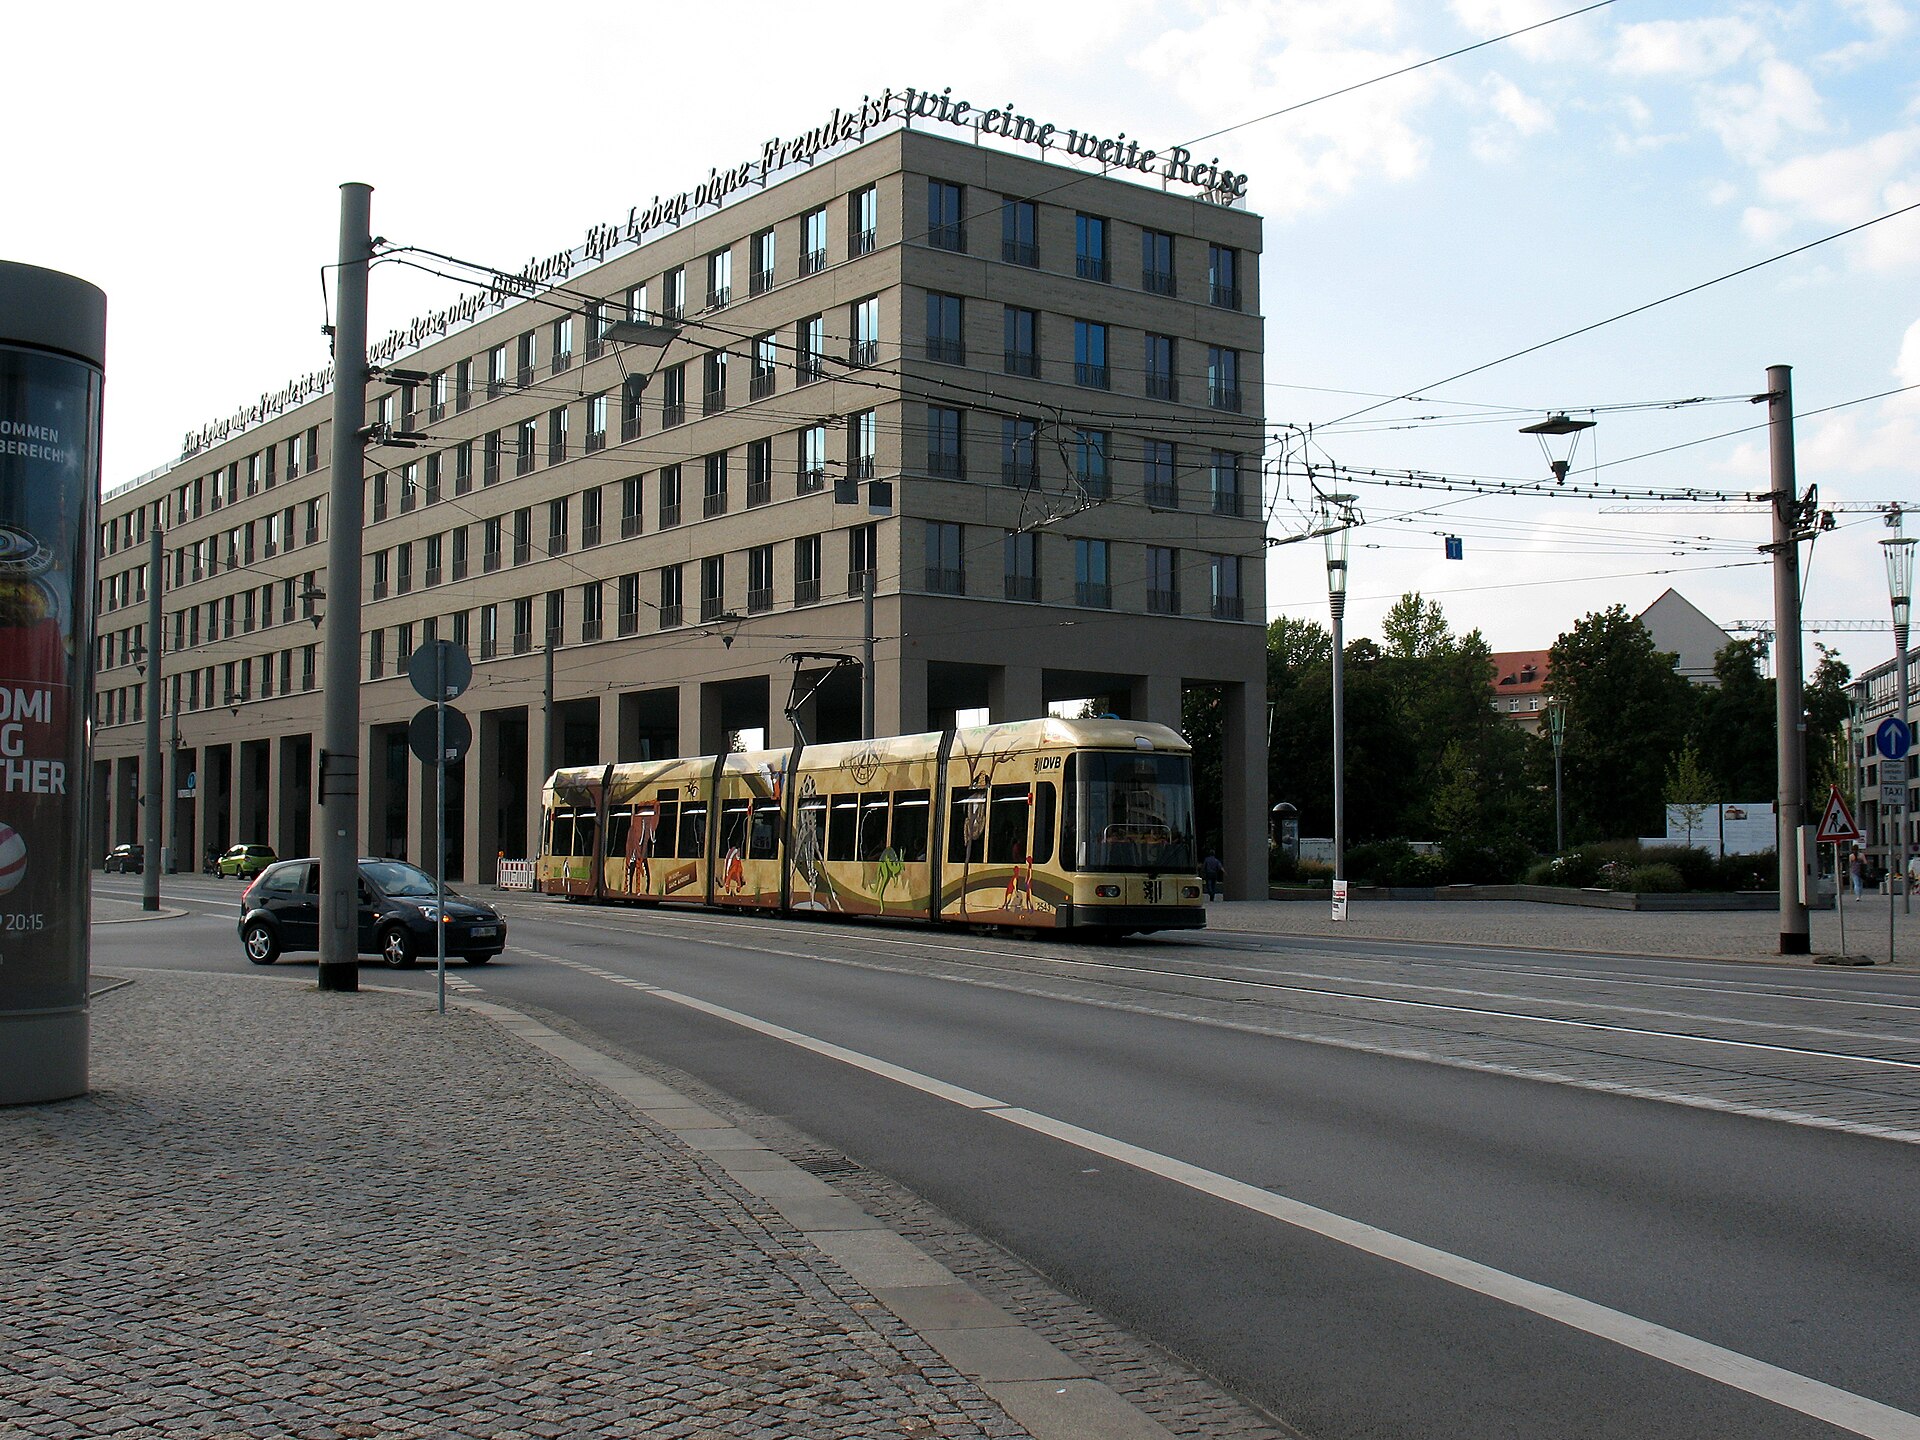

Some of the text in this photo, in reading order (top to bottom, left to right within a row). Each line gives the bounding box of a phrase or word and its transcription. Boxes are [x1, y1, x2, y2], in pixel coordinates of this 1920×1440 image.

[905, 87, 1249, 198] wie eine weite Reise
[582, 87, 892, 260] Ein Leben ohne Freude ist
[367, 329, 406, 364] weite
[408, 309, 446, 343] Reise
[447, 289, 487, 325] ohne
[0, 439, 64, 463] BEREICH!
[1, 723, 24, 757] G
[0, 758, 66, 795] HER
[1042, 756, 1062, 770] DVB
[1884, 786, 1903, 797] TAXI
[6, 914, 44, 930] 20:15
